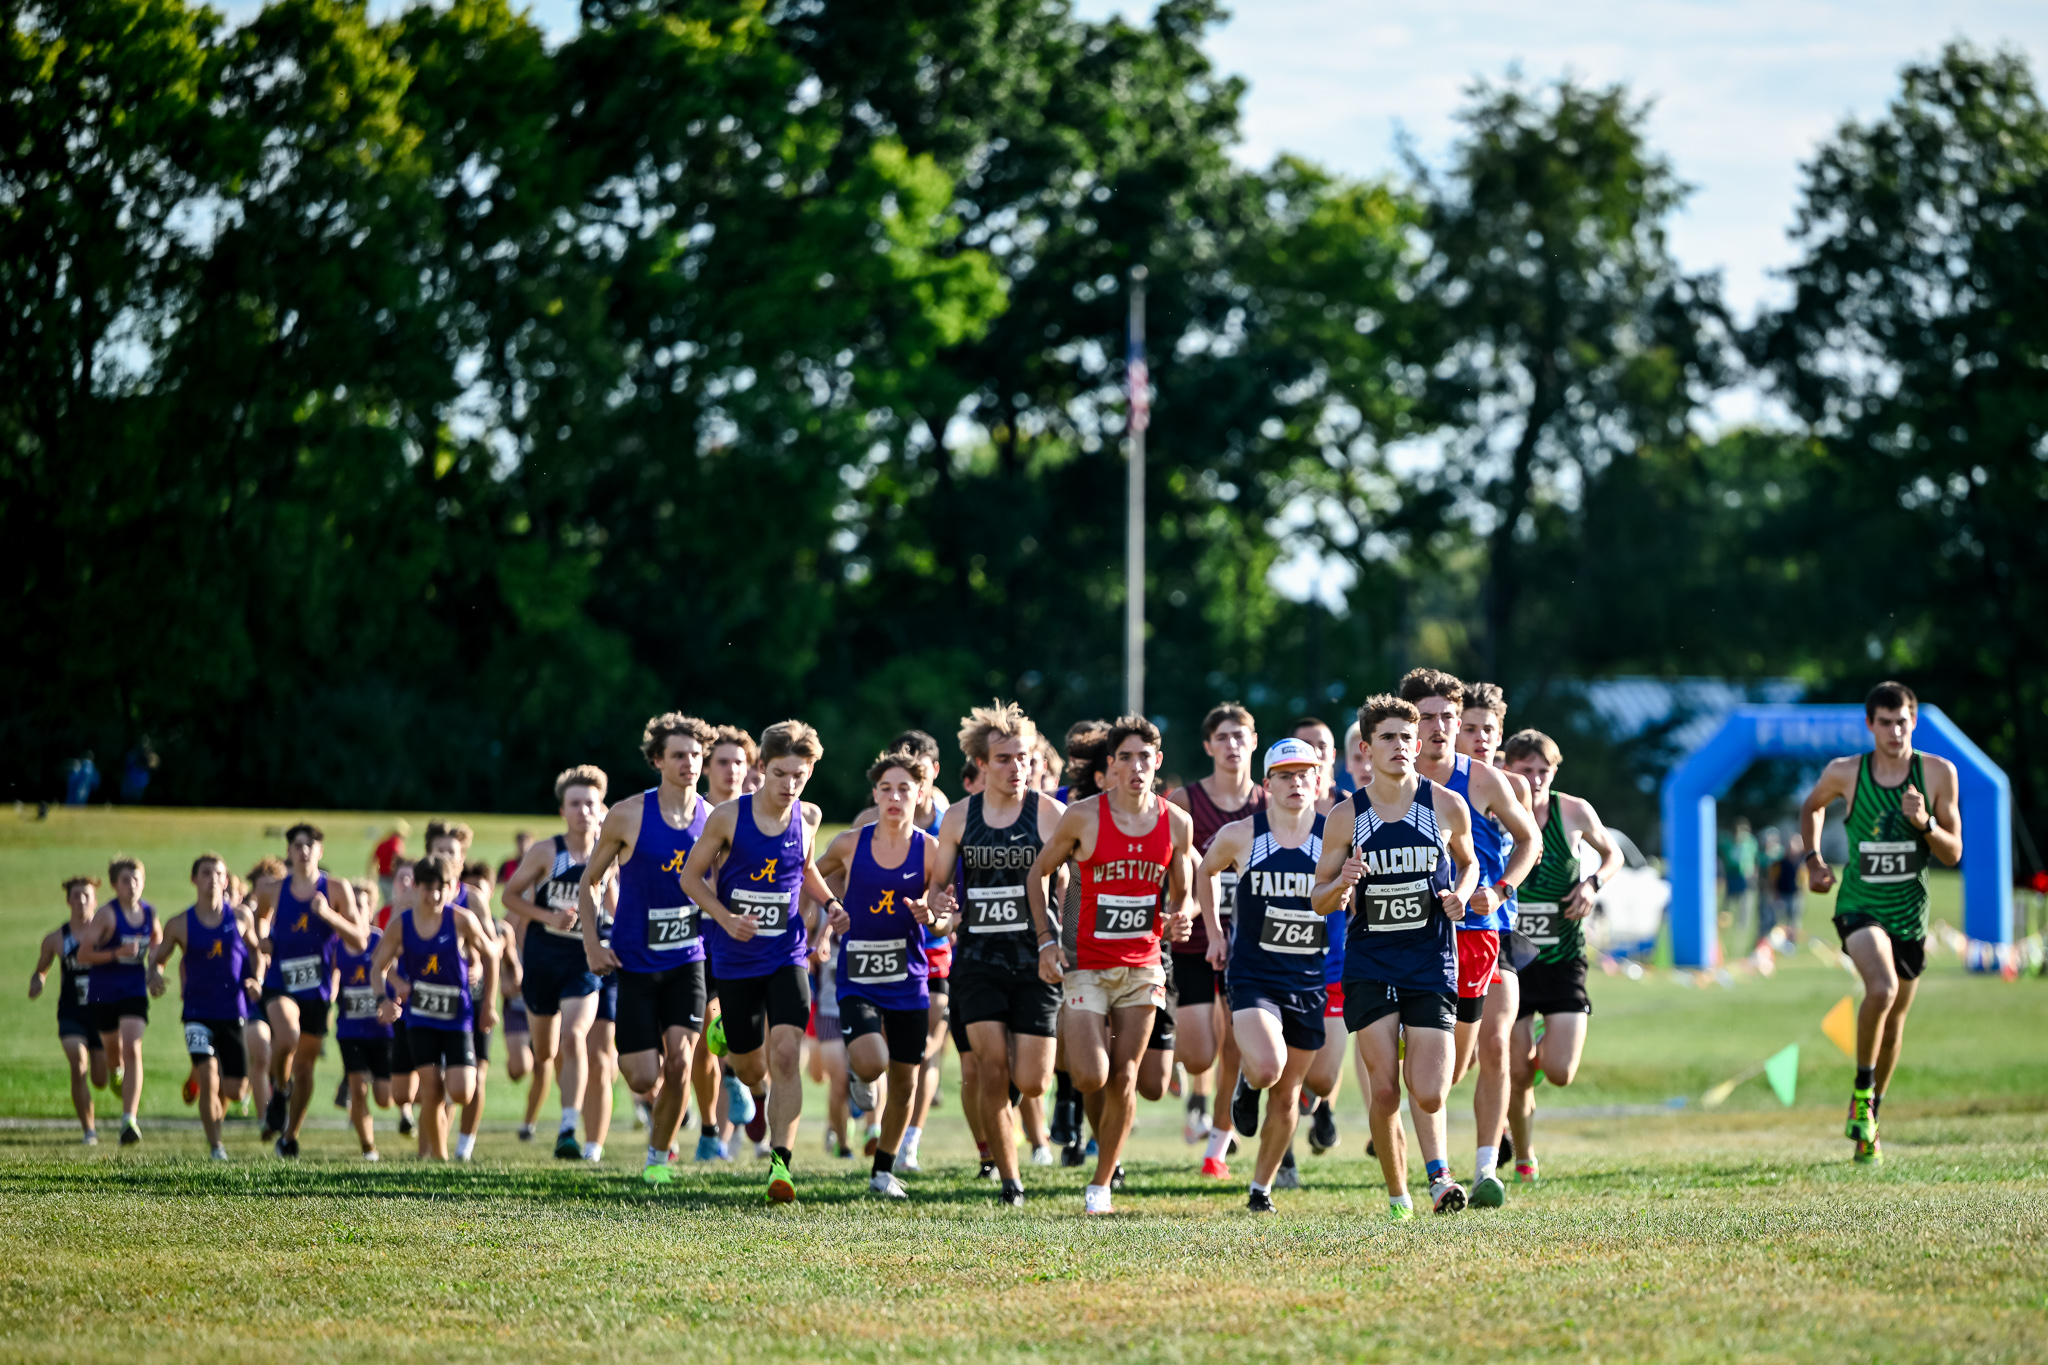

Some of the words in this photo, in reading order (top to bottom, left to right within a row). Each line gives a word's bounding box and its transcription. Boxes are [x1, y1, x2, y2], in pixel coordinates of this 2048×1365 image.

[1755, 719, 1876, 750] FINIS
[963, 846, 1036, 869] BUSCO
[1361, 846, 1439, 877] FALCONS
[1867, 855, 1906, 874] 751
[739, 903, 780, 926] 729
[975, 900, 1018, 922] 746
[1105, 908, 1147, 929] 796
[1373, 896, 1422, 920] 765
[657, 918, 690, 941] 725
[1272, 922, 1314, 944] 764
[856, 952, 898, 974] 735
[288, 966, 318, 985] 733
[420, 993, 450, 1012] 731
